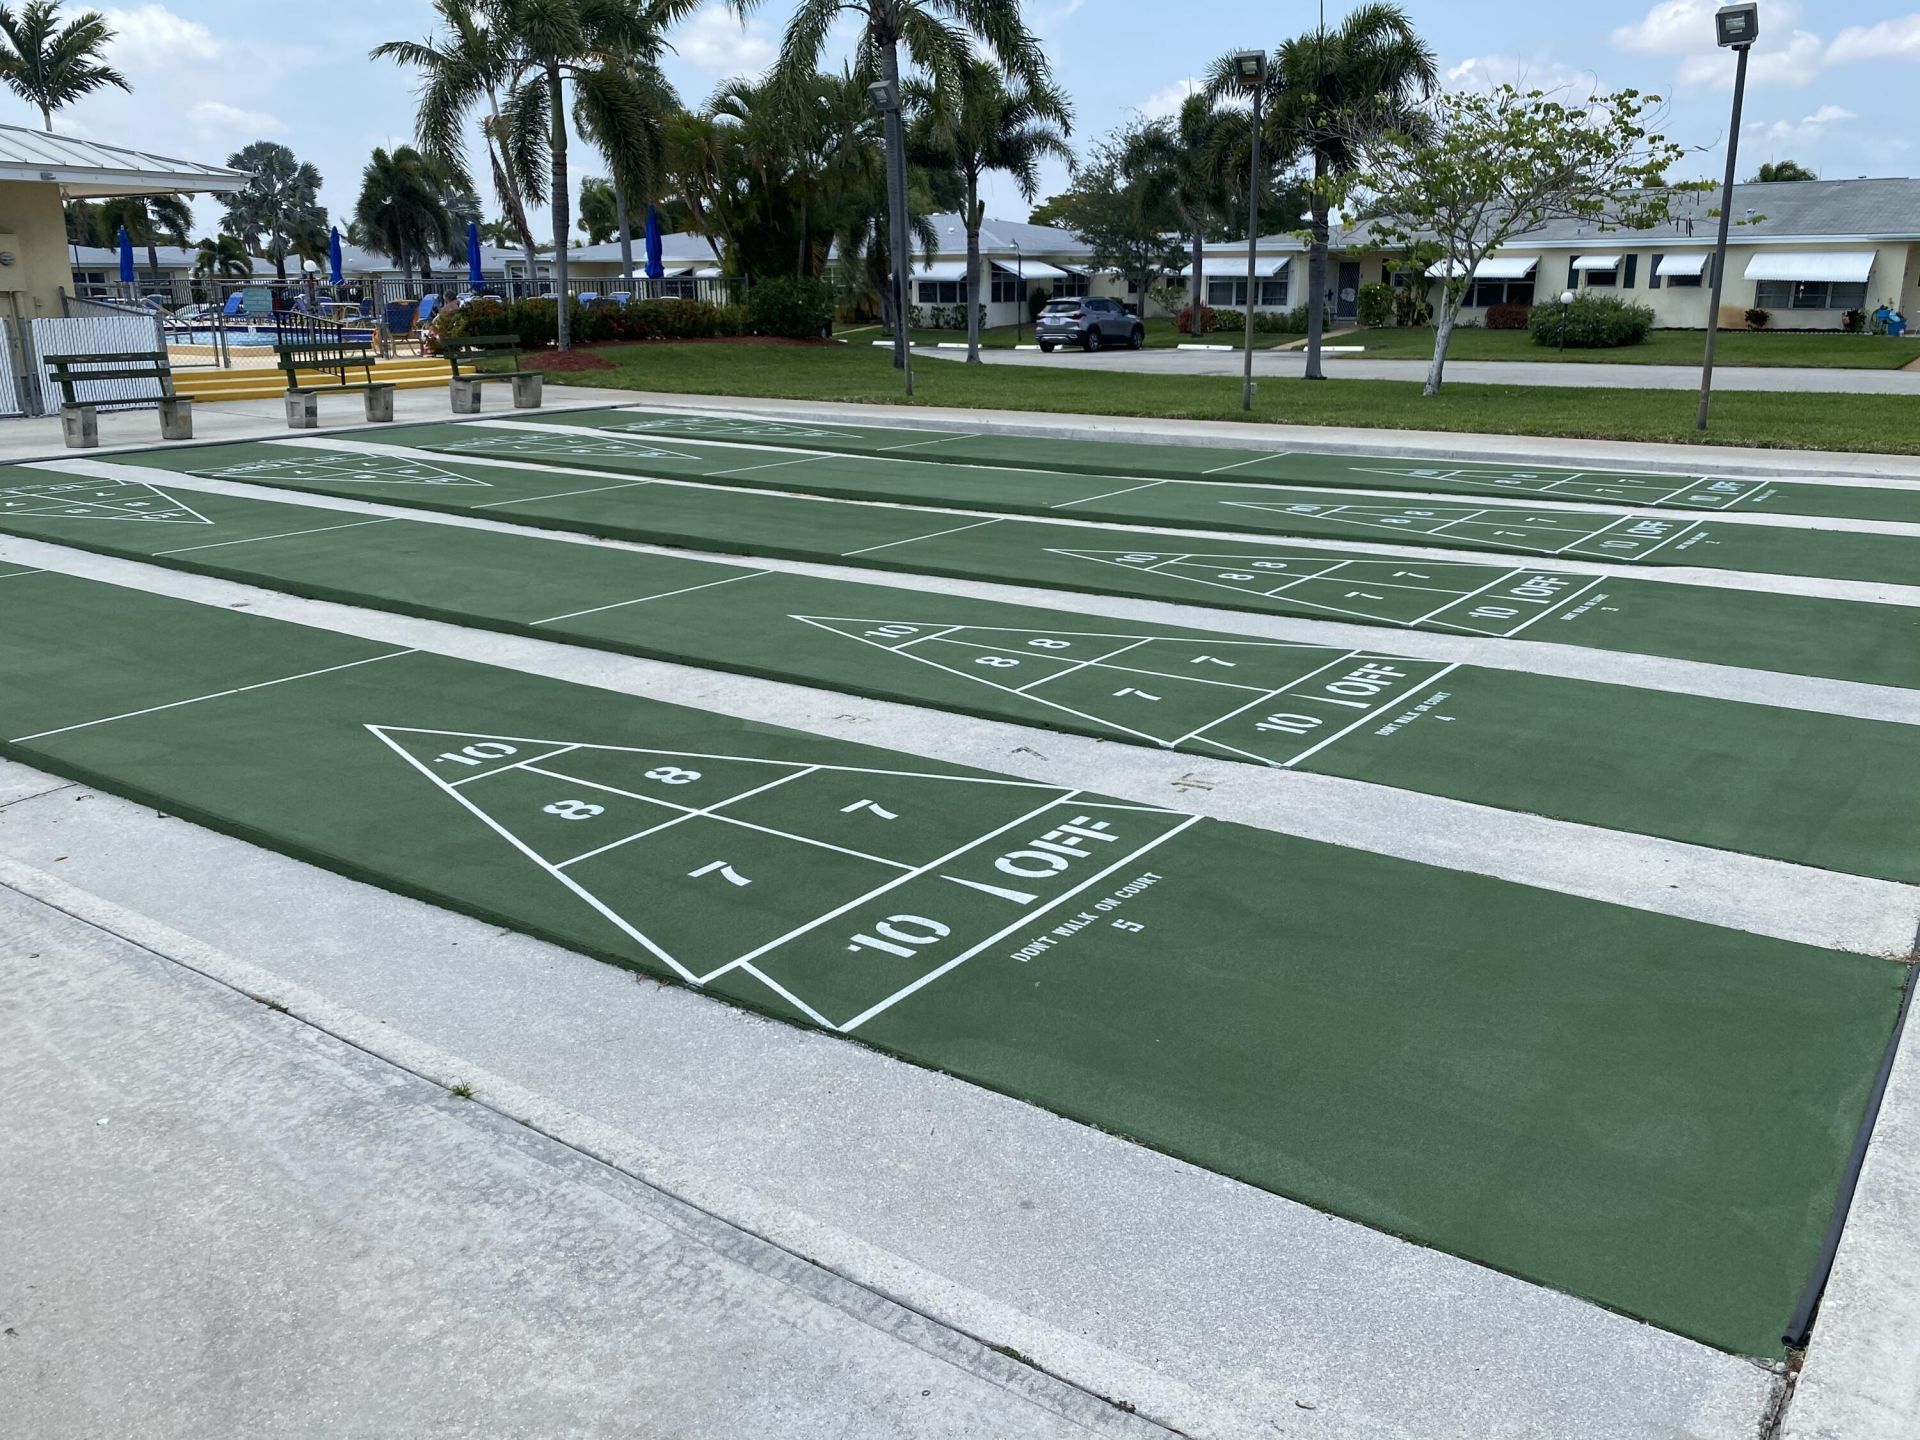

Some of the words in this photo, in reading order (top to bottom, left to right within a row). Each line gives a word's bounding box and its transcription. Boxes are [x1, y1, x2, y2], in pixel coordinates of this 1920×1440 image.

[1218, 573, 1254, 581] 8
[1392, 571, 1430, 579] 7
[1344, 591, 1384, 600] 7
[1468, 606, 1519, 619] 10
[1510, 575, 1570, 597] OFF
[864, 624, 919, 639] 10
[1028, 638, 1071, 649] 8
[974, 656, 1020, 668] 8
[1189, 655, 1237, 667] 7
[1112, 687, 1162, 701] 7
[1255, 713, 1323, 735] 10
[1325, 662, 1407, 696] OFF
[433, 742, 518, 767] 10
[644, 766, 702, 785] 8
[542, 799, 605, 820] 8
[839, 798, 899, 820] 7
[687, 860, 753, 887] 7
[847, 914, 951, 958] 10
[994, 815, 1120, 878] OFF
[1009, 936, 1058, 963] DON'T
[1052, 911, 1099, 937] WALK
[1094, 897, 1122, 911] ON
[1114, 872, 1163, 899] COURT
[1111, 918, 1145, 933] 5
